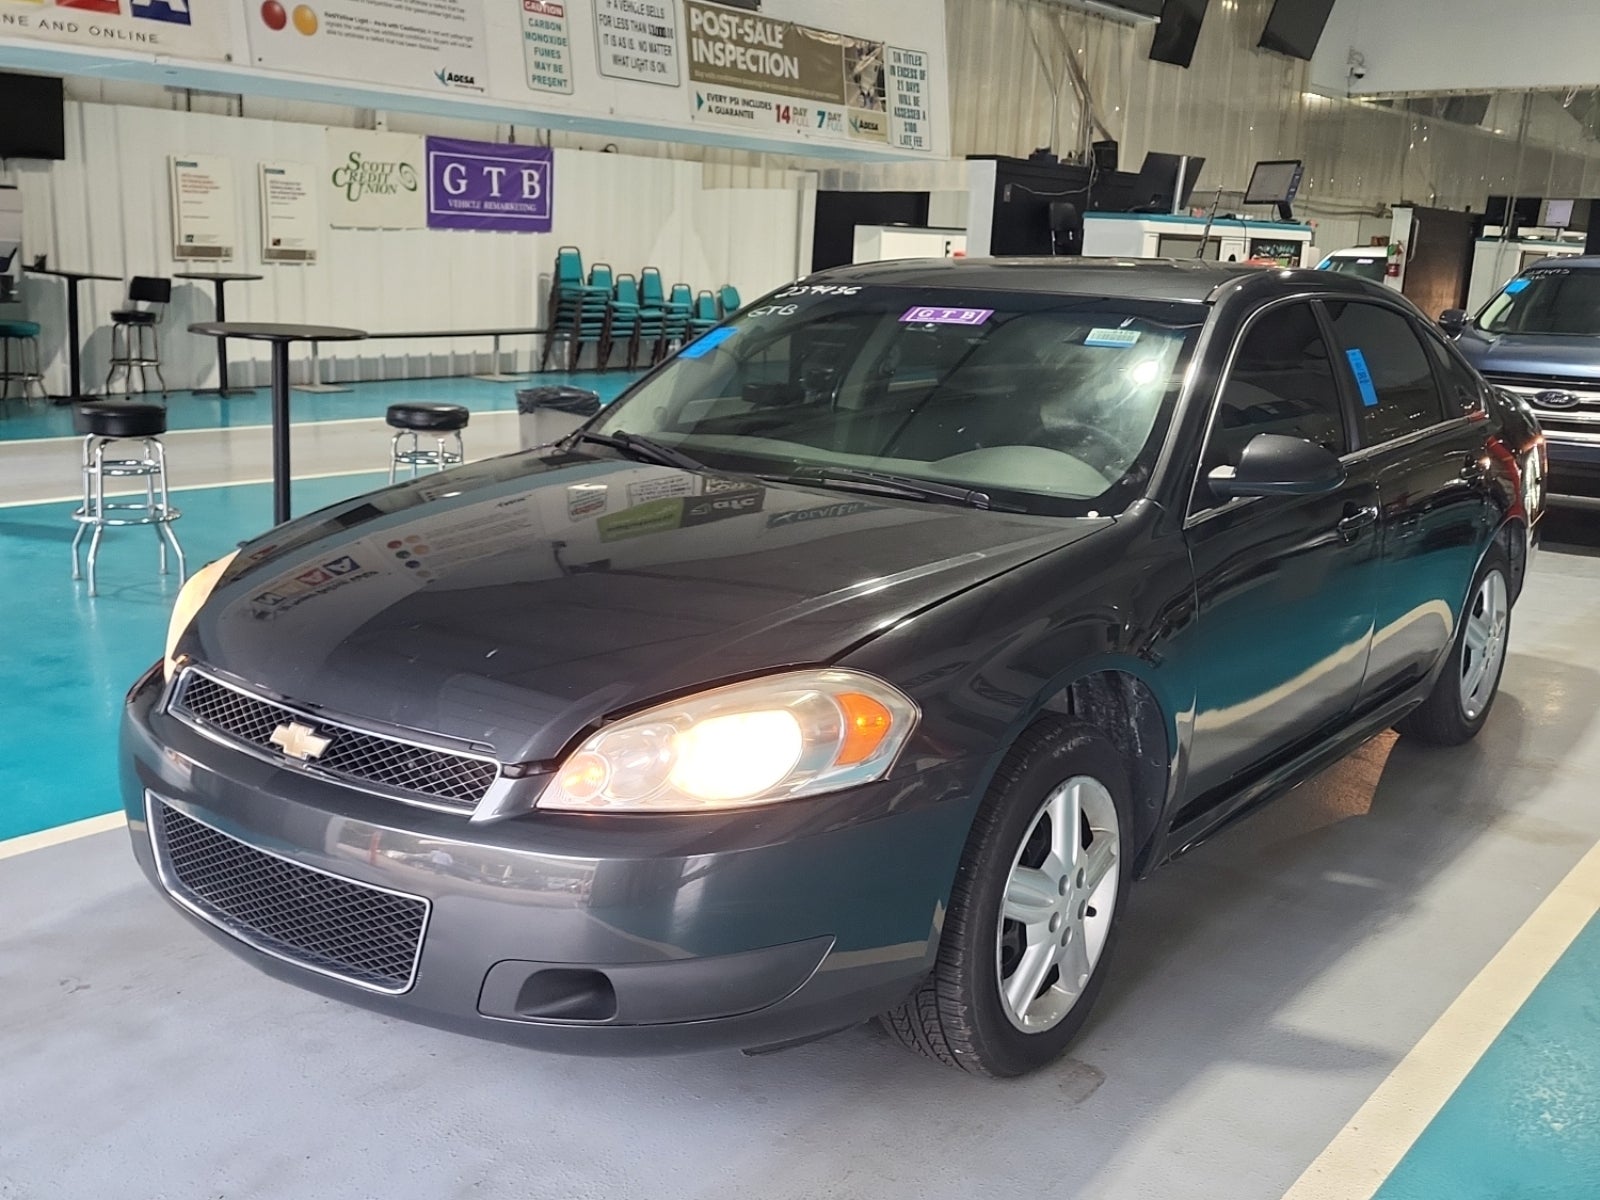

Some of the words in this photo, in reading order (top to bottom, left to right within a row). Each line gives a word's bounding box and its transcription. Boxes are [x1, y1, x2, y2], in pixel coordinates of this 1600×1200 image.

[38, 20, 79, 34] AND
[88, 25, 161, 44] ONLINE
[528, 18, 562, 32] CARBON
[689, 7, 784, 49] POST-SALE
[524, 31, 568, 47] MONOXIDE
[534, 46, 561, 60] FUMES
[691, 37, 800, 80] INSPECTION
[534, 60, 552, 72] MAY
[553, 64, 563, 74] BE
[532, 74, 568, 88] PRESENT
[706, 93, 728, 104] EVERY
[741, 98, 772, 110] INCLUDES
[708, 105, 713, 113] A
[714, 107, 754, 120] GUARANTEE
[776, 104, 791, 124] 14
[792, 106, 808, 117] DAY
[816, 110, 826, 129] 7
[827, 112, 842, 122] DAY
[448, 199, 481, 209] VEHICLE
[483, 200, 537, 212] REMARKETING
